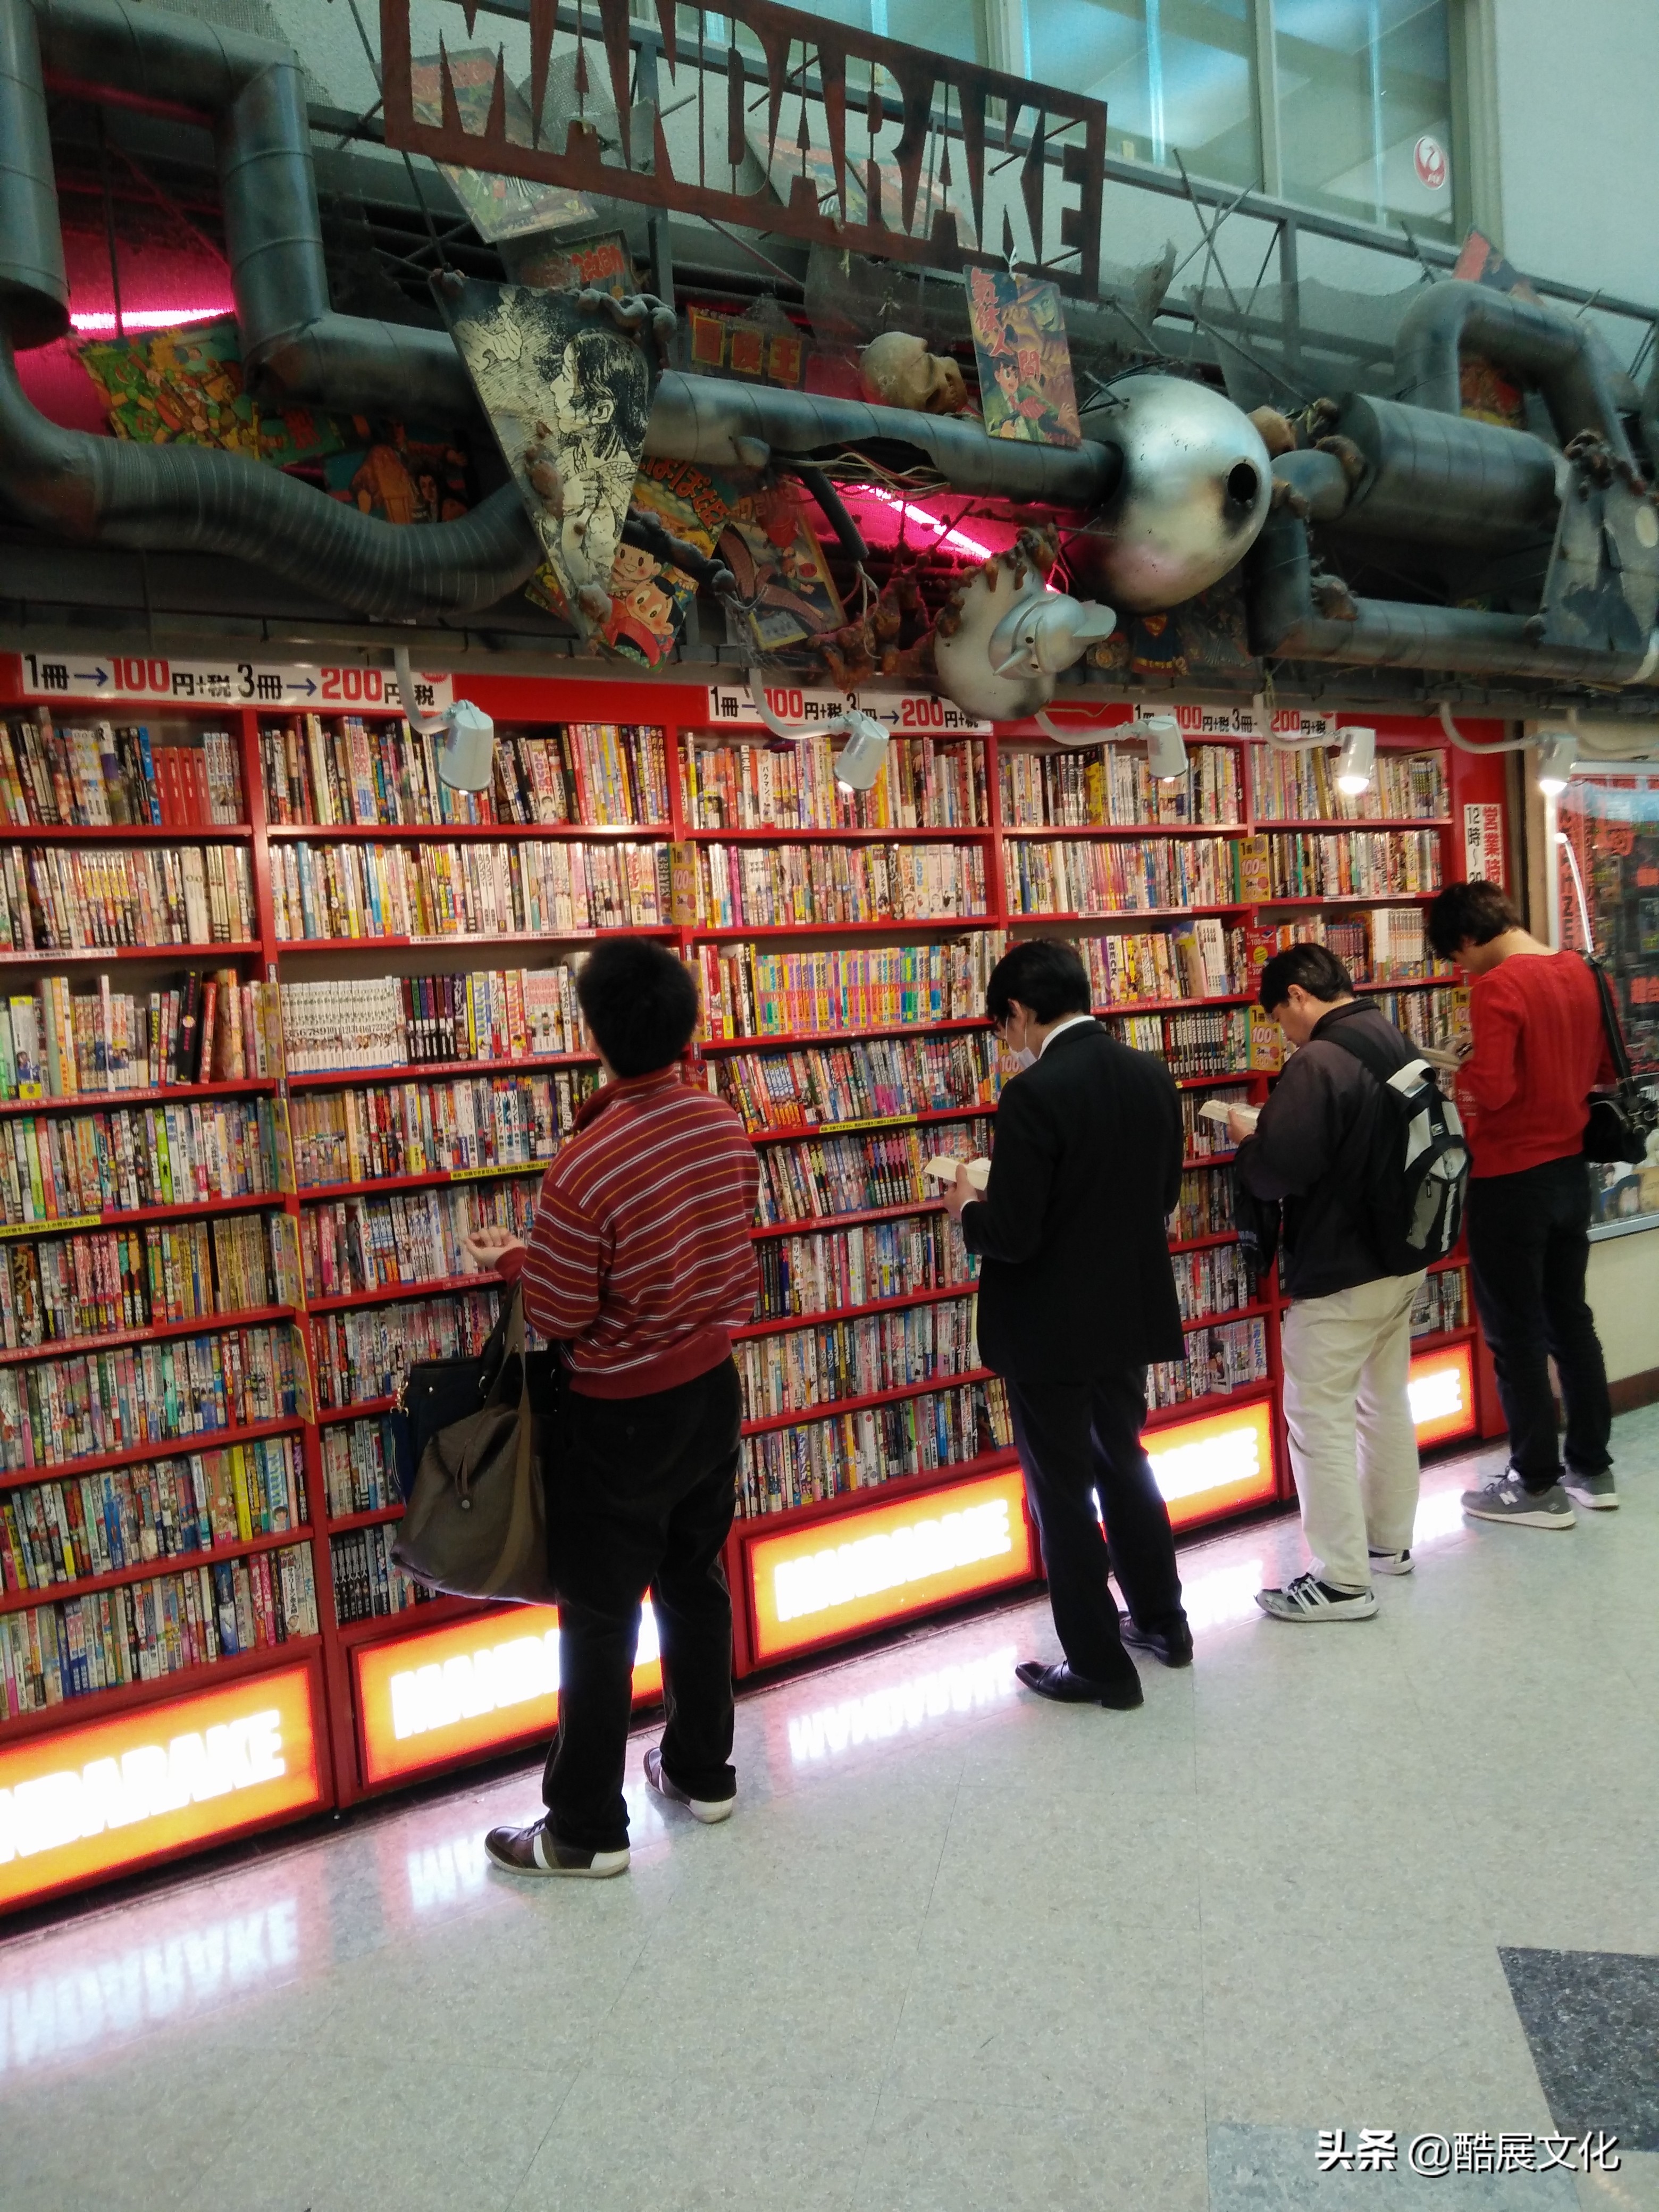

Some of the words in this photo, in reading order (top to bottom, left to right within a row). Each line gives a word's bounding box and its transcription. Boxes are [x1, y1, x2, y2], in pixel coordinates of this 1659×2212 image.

[410, 0, 1087, 274] MANDARAKE
[23, 654, 70, 690] 1冊
[237, 664, 283, 700] 3冊
[320, 668, 435, 706] 200円税
[710, 686, 739, 718] 1冊
[1108, 942, 1117, 975] BECK
